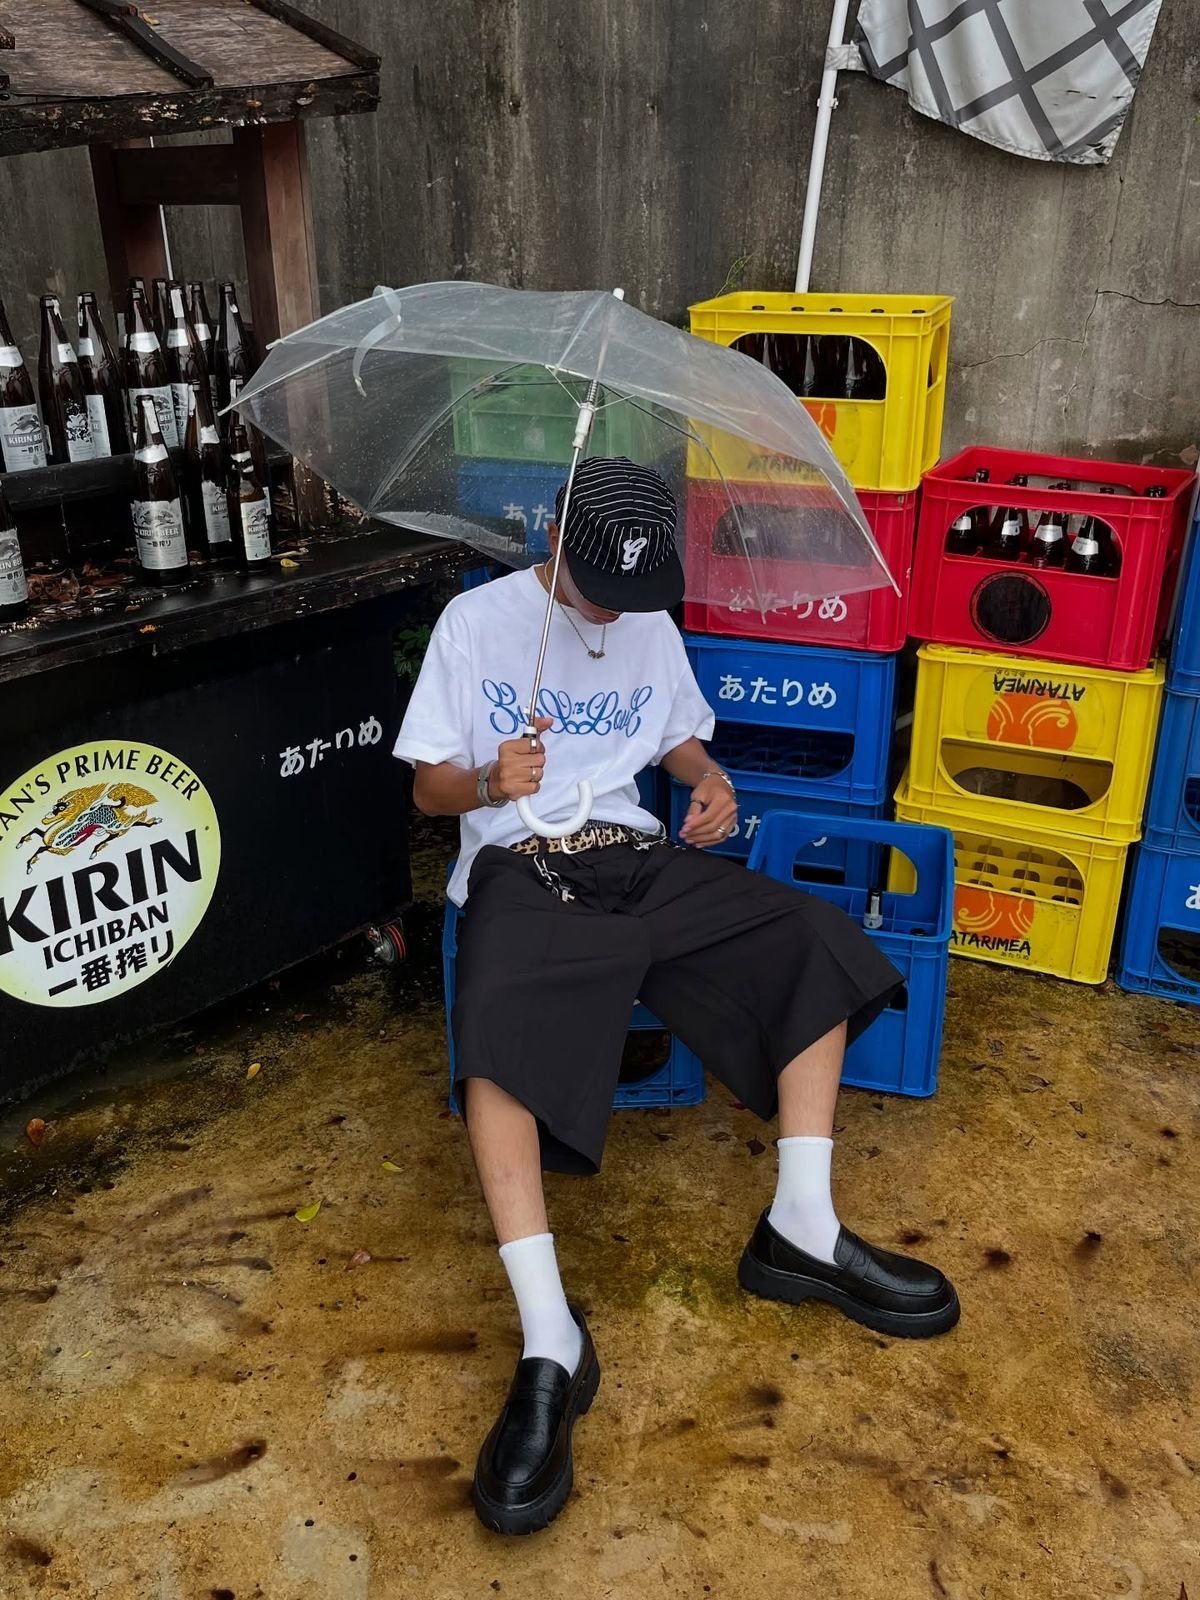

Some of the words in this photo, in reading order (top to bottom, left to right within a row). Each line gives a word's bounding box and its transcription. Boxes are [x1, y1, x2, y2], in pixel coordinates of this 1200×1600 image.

[747, 454, 821, 473] ATARIM
[718, 674, 838, 710] あたりめ
[993, 673, 1086, 702] ATARIMEA
[279, 715, 383, 778] あたりめ
[0, 773, 51, 841] AN'S
[56, 749, 141, 784] PRIME
[145, 754, 200, 801] BEER
[0, 829, 202, 957] KIRIN
[43, 900, 169, 970] ICHIBAN
[48, 929, 174, 998] 一番搾り
[949, 929, 1032, 957] ATARIMEA
